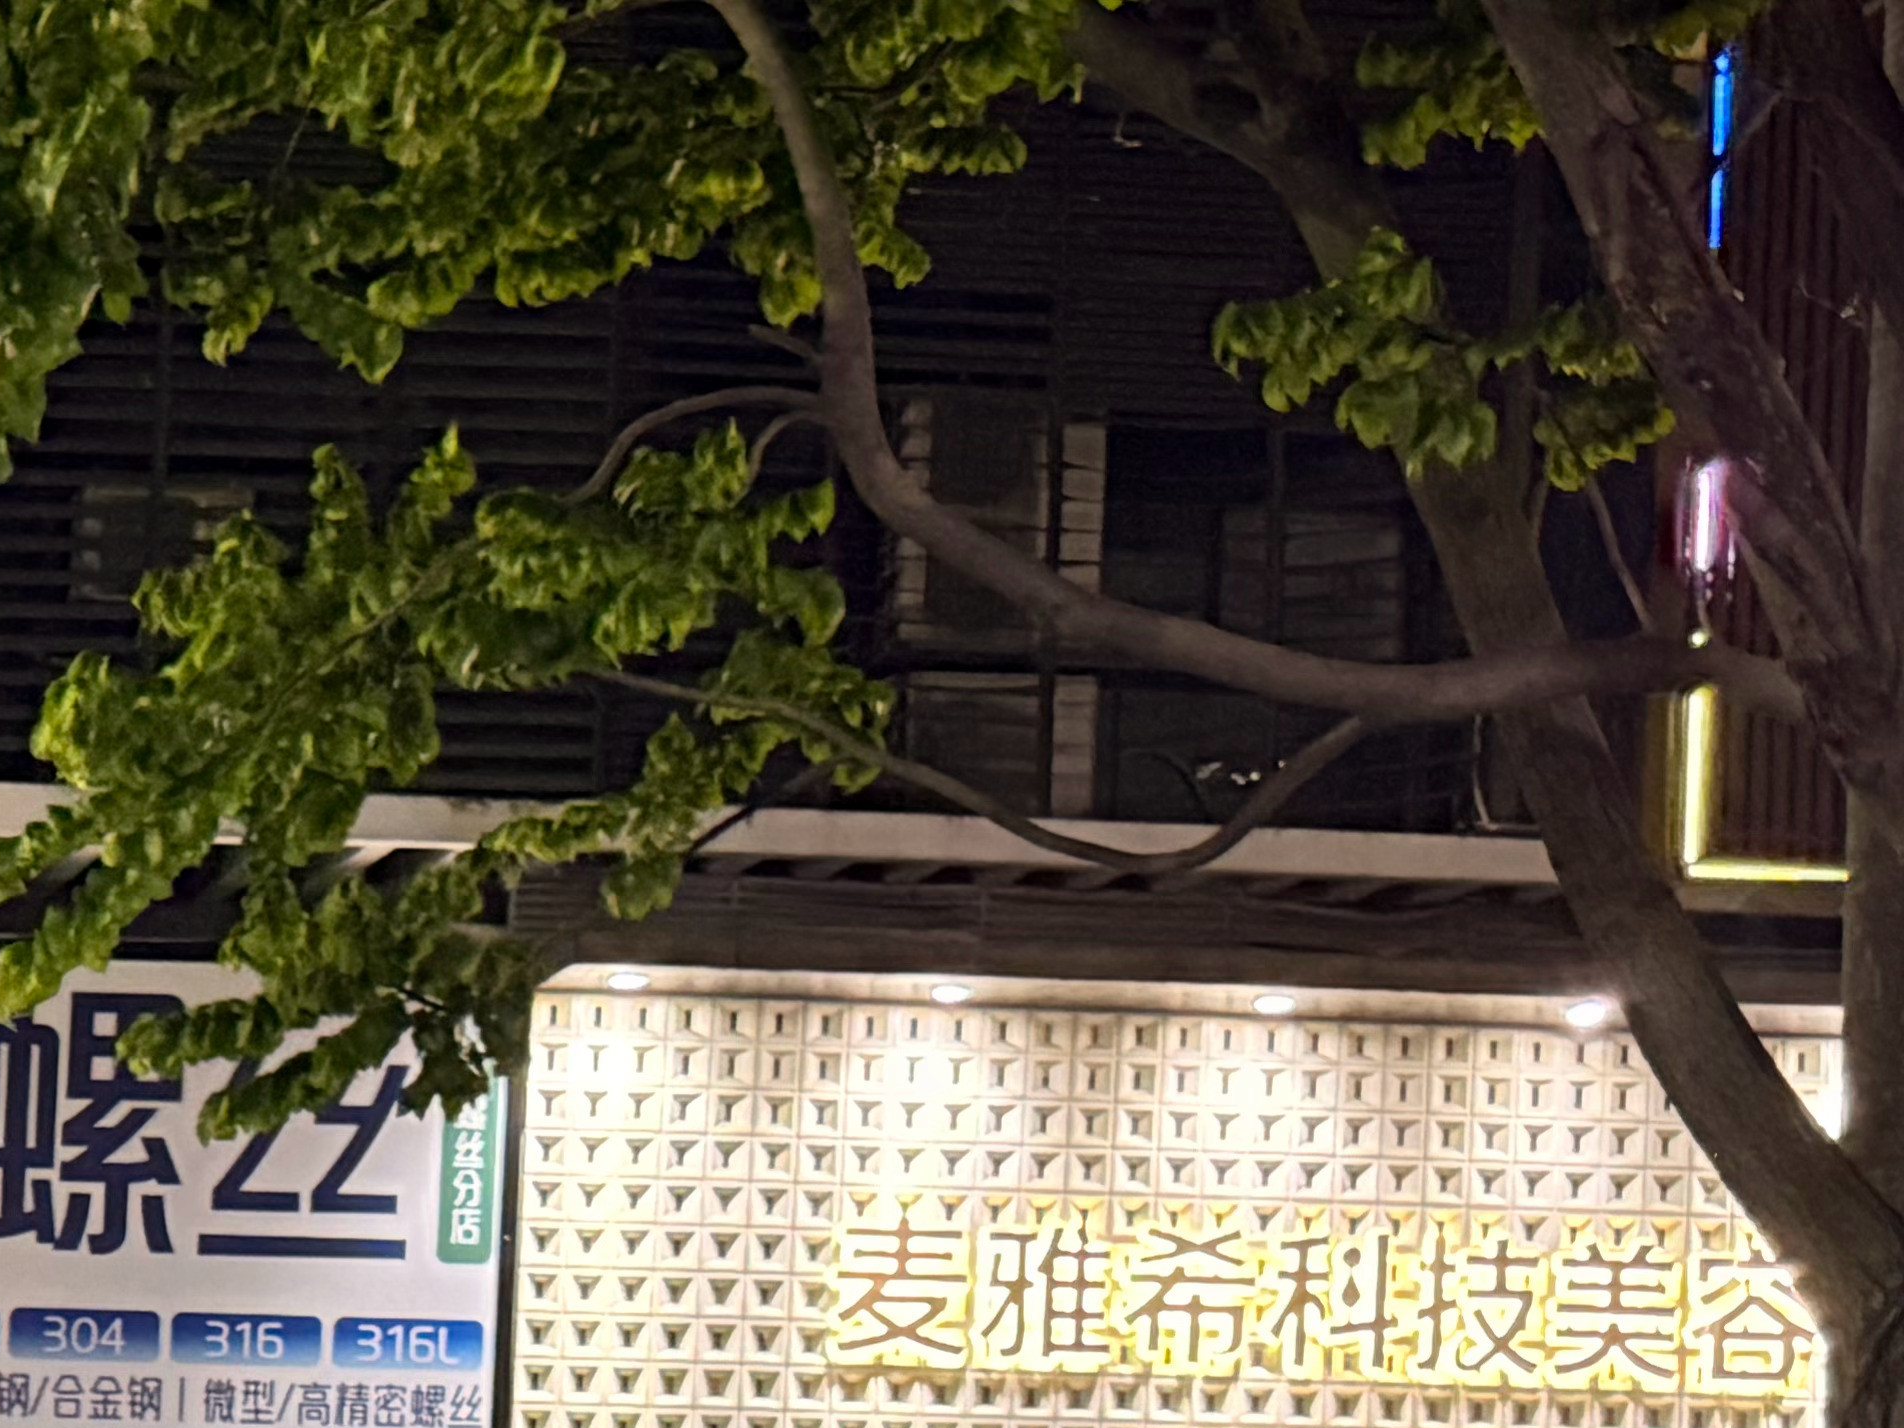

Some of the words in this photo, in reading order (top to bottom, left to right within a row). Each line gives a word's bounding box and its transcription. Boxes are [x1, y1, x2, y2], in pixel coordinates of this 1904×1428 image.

[837, 1214, 1815, 1381] 麦雅希科技美容
[42, 1315, 126, 1356] 304
[204, 1319, 285, 1360] 316
[355, 1323, 461, 1365] 316L
